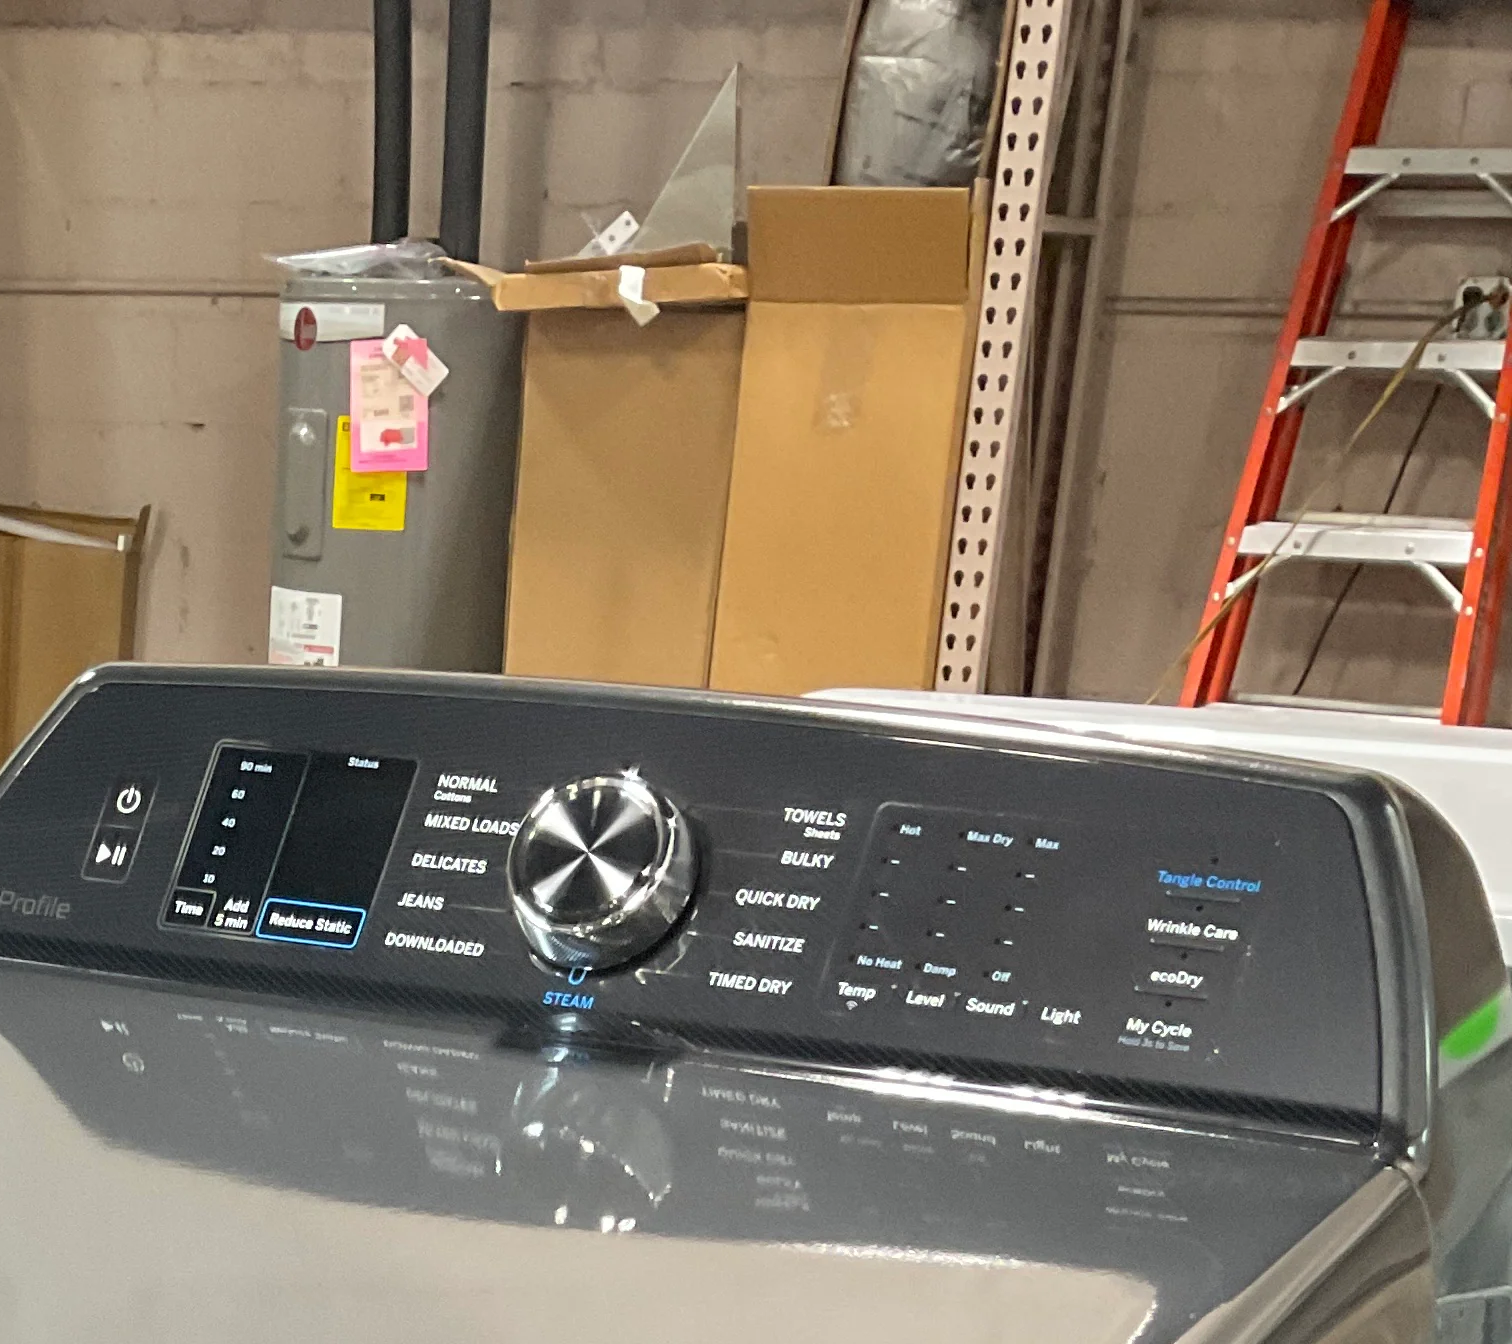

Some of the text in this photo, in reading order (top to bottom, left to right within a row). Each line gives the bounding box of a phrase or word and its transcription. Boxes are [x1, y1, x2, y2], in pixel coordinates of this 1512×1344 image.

[347, 756, 380, 769] Status
[438, 774, 498, 793] NORMAL
[231, 789, 246, 800] 60
[221, 818, 236, 828] 40
[424, 813, 521, 837] MIXED LOADS
[783, 807, 847, 827] TOWELS
[803, 826, 841, 840] Sheets
[899, 824, 922, 836] Hot
[966, 831, 1014, 847] Max Dry
[211, 846, 226, 856] 20
[1034, 838, 1060, 850] Max
[411, 852, 488, 874] DELICATES
[780, 850, 835, 868] BULKY
[203, 873, 216, 884] 10
[1158, 870, 1262, 893] Tangle Control
[175, 900, 204, 916] Time
[223, 898, 250, 914] Add
[397, 893, 445, 911] JEANS
[735, 888, 821, 911] QUICK DRY
[214, 913, 249, 929] 5 min
[269, 912, 353, 935] Reduce Static
[1147, 918, 1239, 940] Wrinkle Care
[384, 931, 485, 957] DOWNLOADED
[732, 931, 806, 953] SANITIZE
[856, 955, 903, 970] No Heat
[923, 963, 957, 977] Damp
[709, 971, 793, 995] TIMED DRY
[1150, 971, 1204, 988] ecoDry
[543, 991, 594, 1009] STEAM
[838, 982, 877, 1000] Temp
[905, 990, 946, 1007] Level
[965, 998, 1015, 1016] Sound
[1040, 1007, 1082, 1025] Light
[1126, 1018, 1193, 1038] My Cycle
